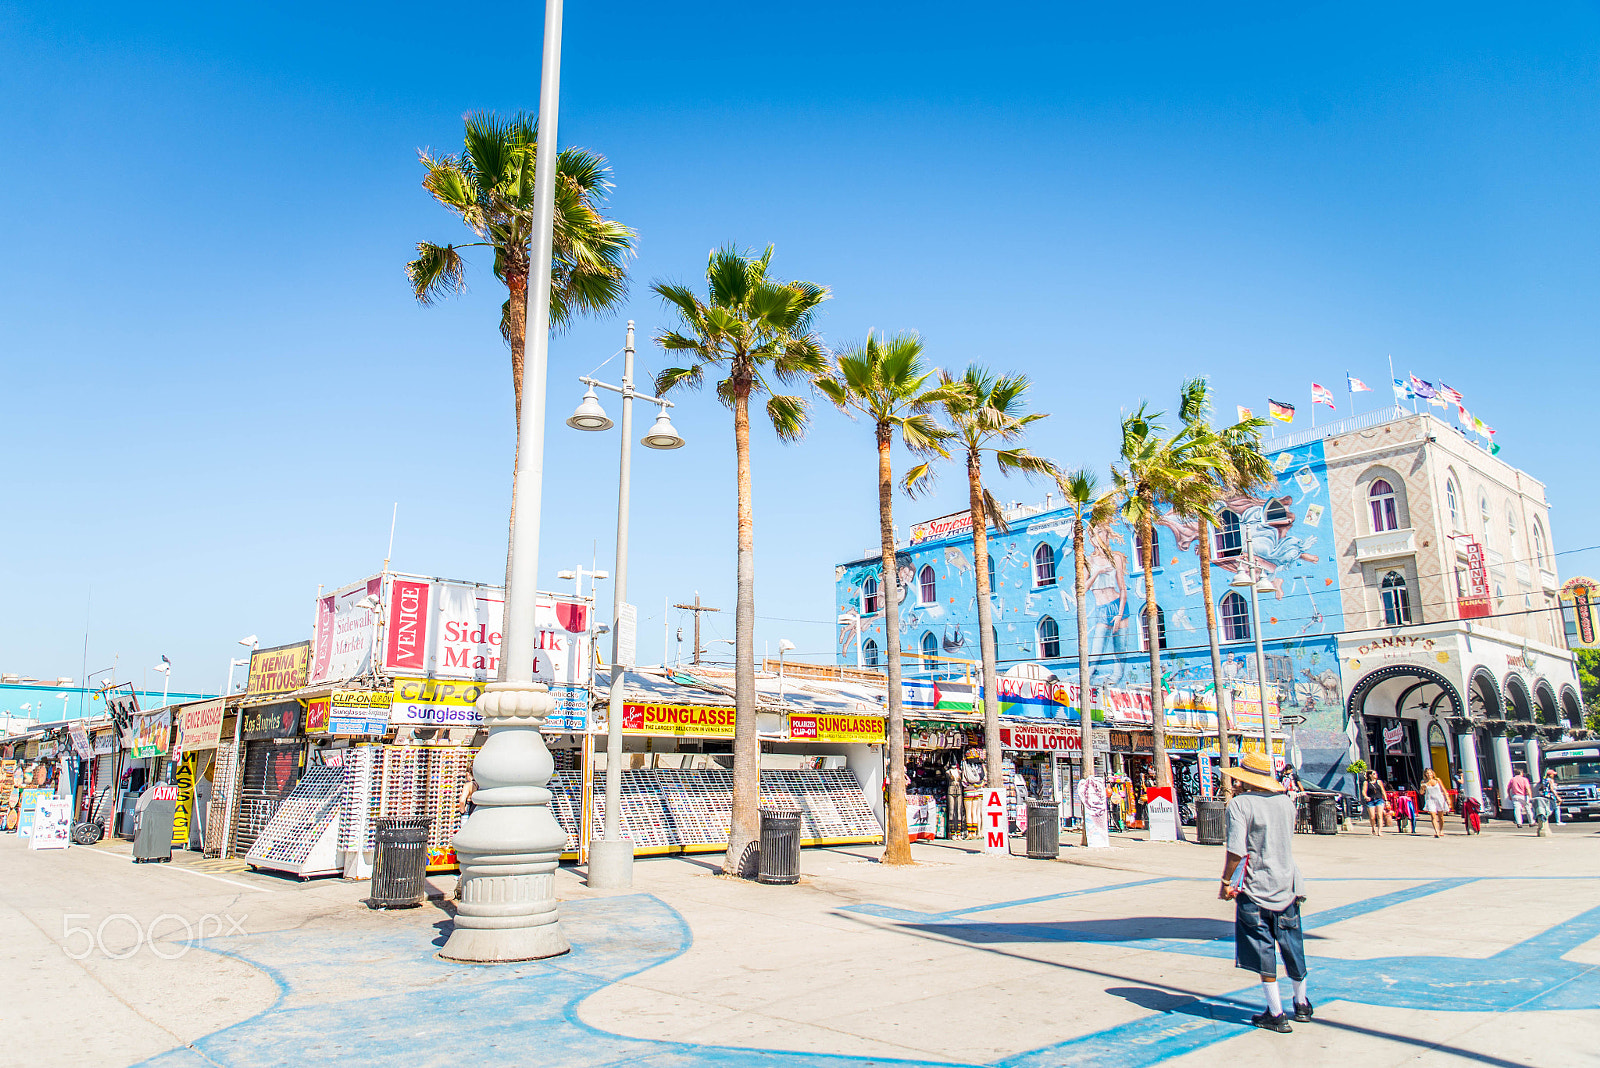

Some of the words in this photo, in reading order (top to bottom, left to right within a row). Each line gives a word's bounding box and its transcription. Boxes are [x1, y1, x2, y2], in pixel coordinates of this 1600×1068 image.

[928, 515, 974, 536] Samesu
[336, 609, 373, 635] Sidewalk
[396, 587, 420, 662] VENICE
[444, 620, 563, 651] Sidelk
[334, 636, 365, 656] Market
[1358, 636, 1436, 655] DANNY'S
[252, 655, 258, 672] 2
[261, 653, 295, 673] HENNA
[301, 646, 308, 665] 2
[442, 646, 540, 674] Mart
[256, 670, 297, 692] TATTOOS
[996, 678, 1024, 697] UCKY
[1029, 681, 1065, 701] VENCE
[400, 682, 482, 704] CLIP-O
[549, 691, 580, 699] unblocks
[332, 708, 367, 717] Sunglasse
[407, 705, 484, 723] Sunglasse
[645, 706, 735, 726] SUNGLASSE
[565, 718, 582, 727] Toys
[793, 720, 816, 728] POLARIZED
[793, 728, 816, 736] CLIP-ON
[818, 717, 883, 734] SUNGLASSES
[1015, 726, 1055, 734] CONVENIENCE
[1014, 734, 1039, 749] SUN
[1042, 735, 1082, 750] LOTION
[1174, 736, 1198, 749] LESSONS
[153, 787, 178, 800] ATM
[172, 752, 196, 840] MASSAGE
[987, 791, 1004, 848] ATM
